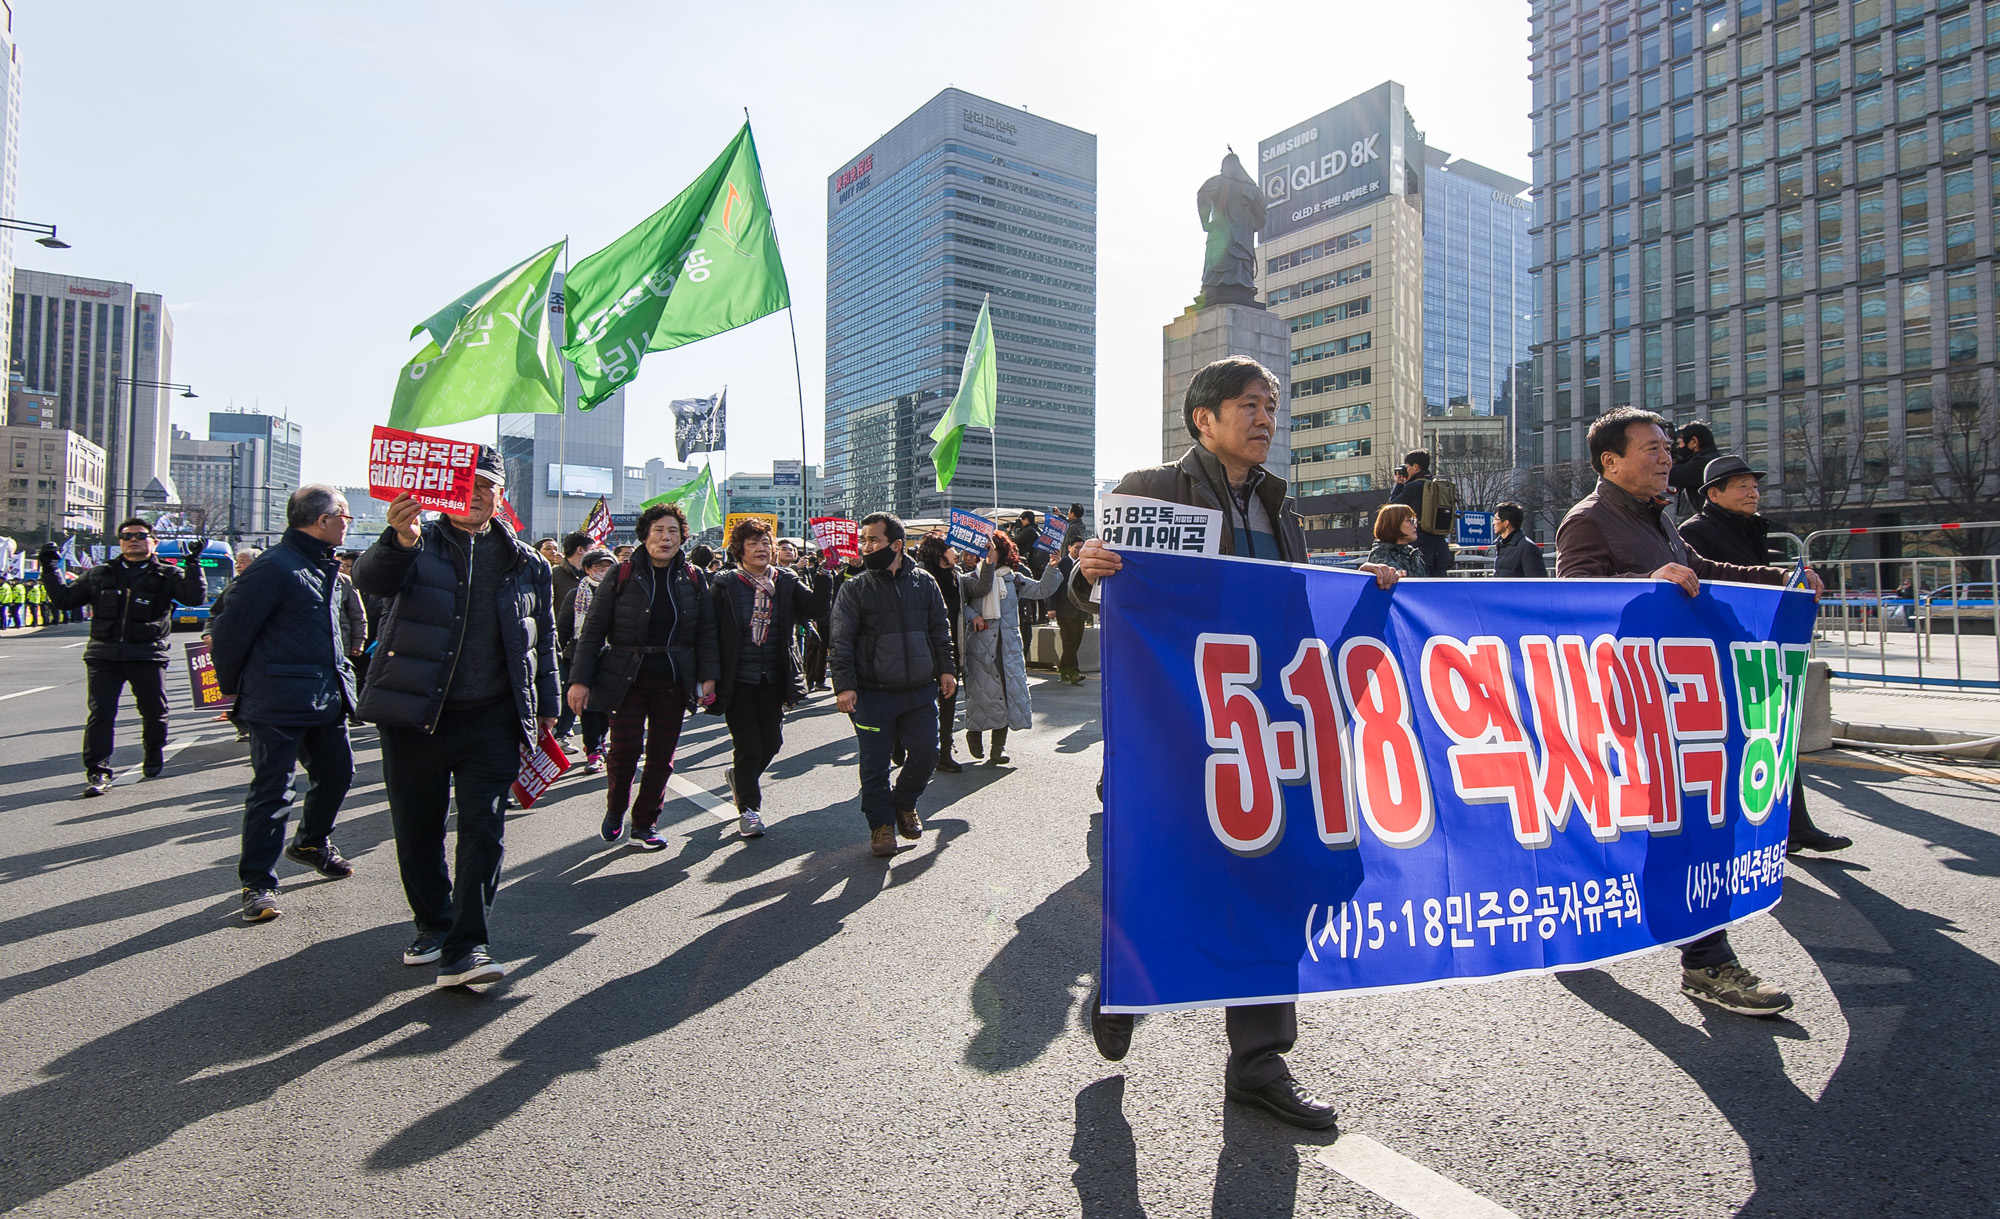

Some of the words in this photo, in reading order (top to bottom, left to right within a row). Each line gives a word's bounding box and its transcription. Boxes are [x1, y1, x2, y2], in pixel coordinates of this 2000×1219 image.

[1262, 127, 1319, 162] SAMSUNG
[1291, 149, 1348, 191] QLED
[1350, 132, 1380, 168] 8K
[839, 186, 854, 205] DUTY
[855, 174, 871, 193] FREE
[1291, 206, 1313, 222] QLED
[1369, 180, 1380, 192] 8K
[69, 285, 110, 298] kobaco
[371, 439, 474, 468] 자유한국당
[370, 463, 454, 491] 해체하라!
[1103, 506, 1174, 525] 5.18모독
[1195, 633, 1433, 853] 5·18
[1421, 634, 1727, 846] 역사왜곡
[1305, 873, 1641, 962] (사)5·18민주유공자유족회
